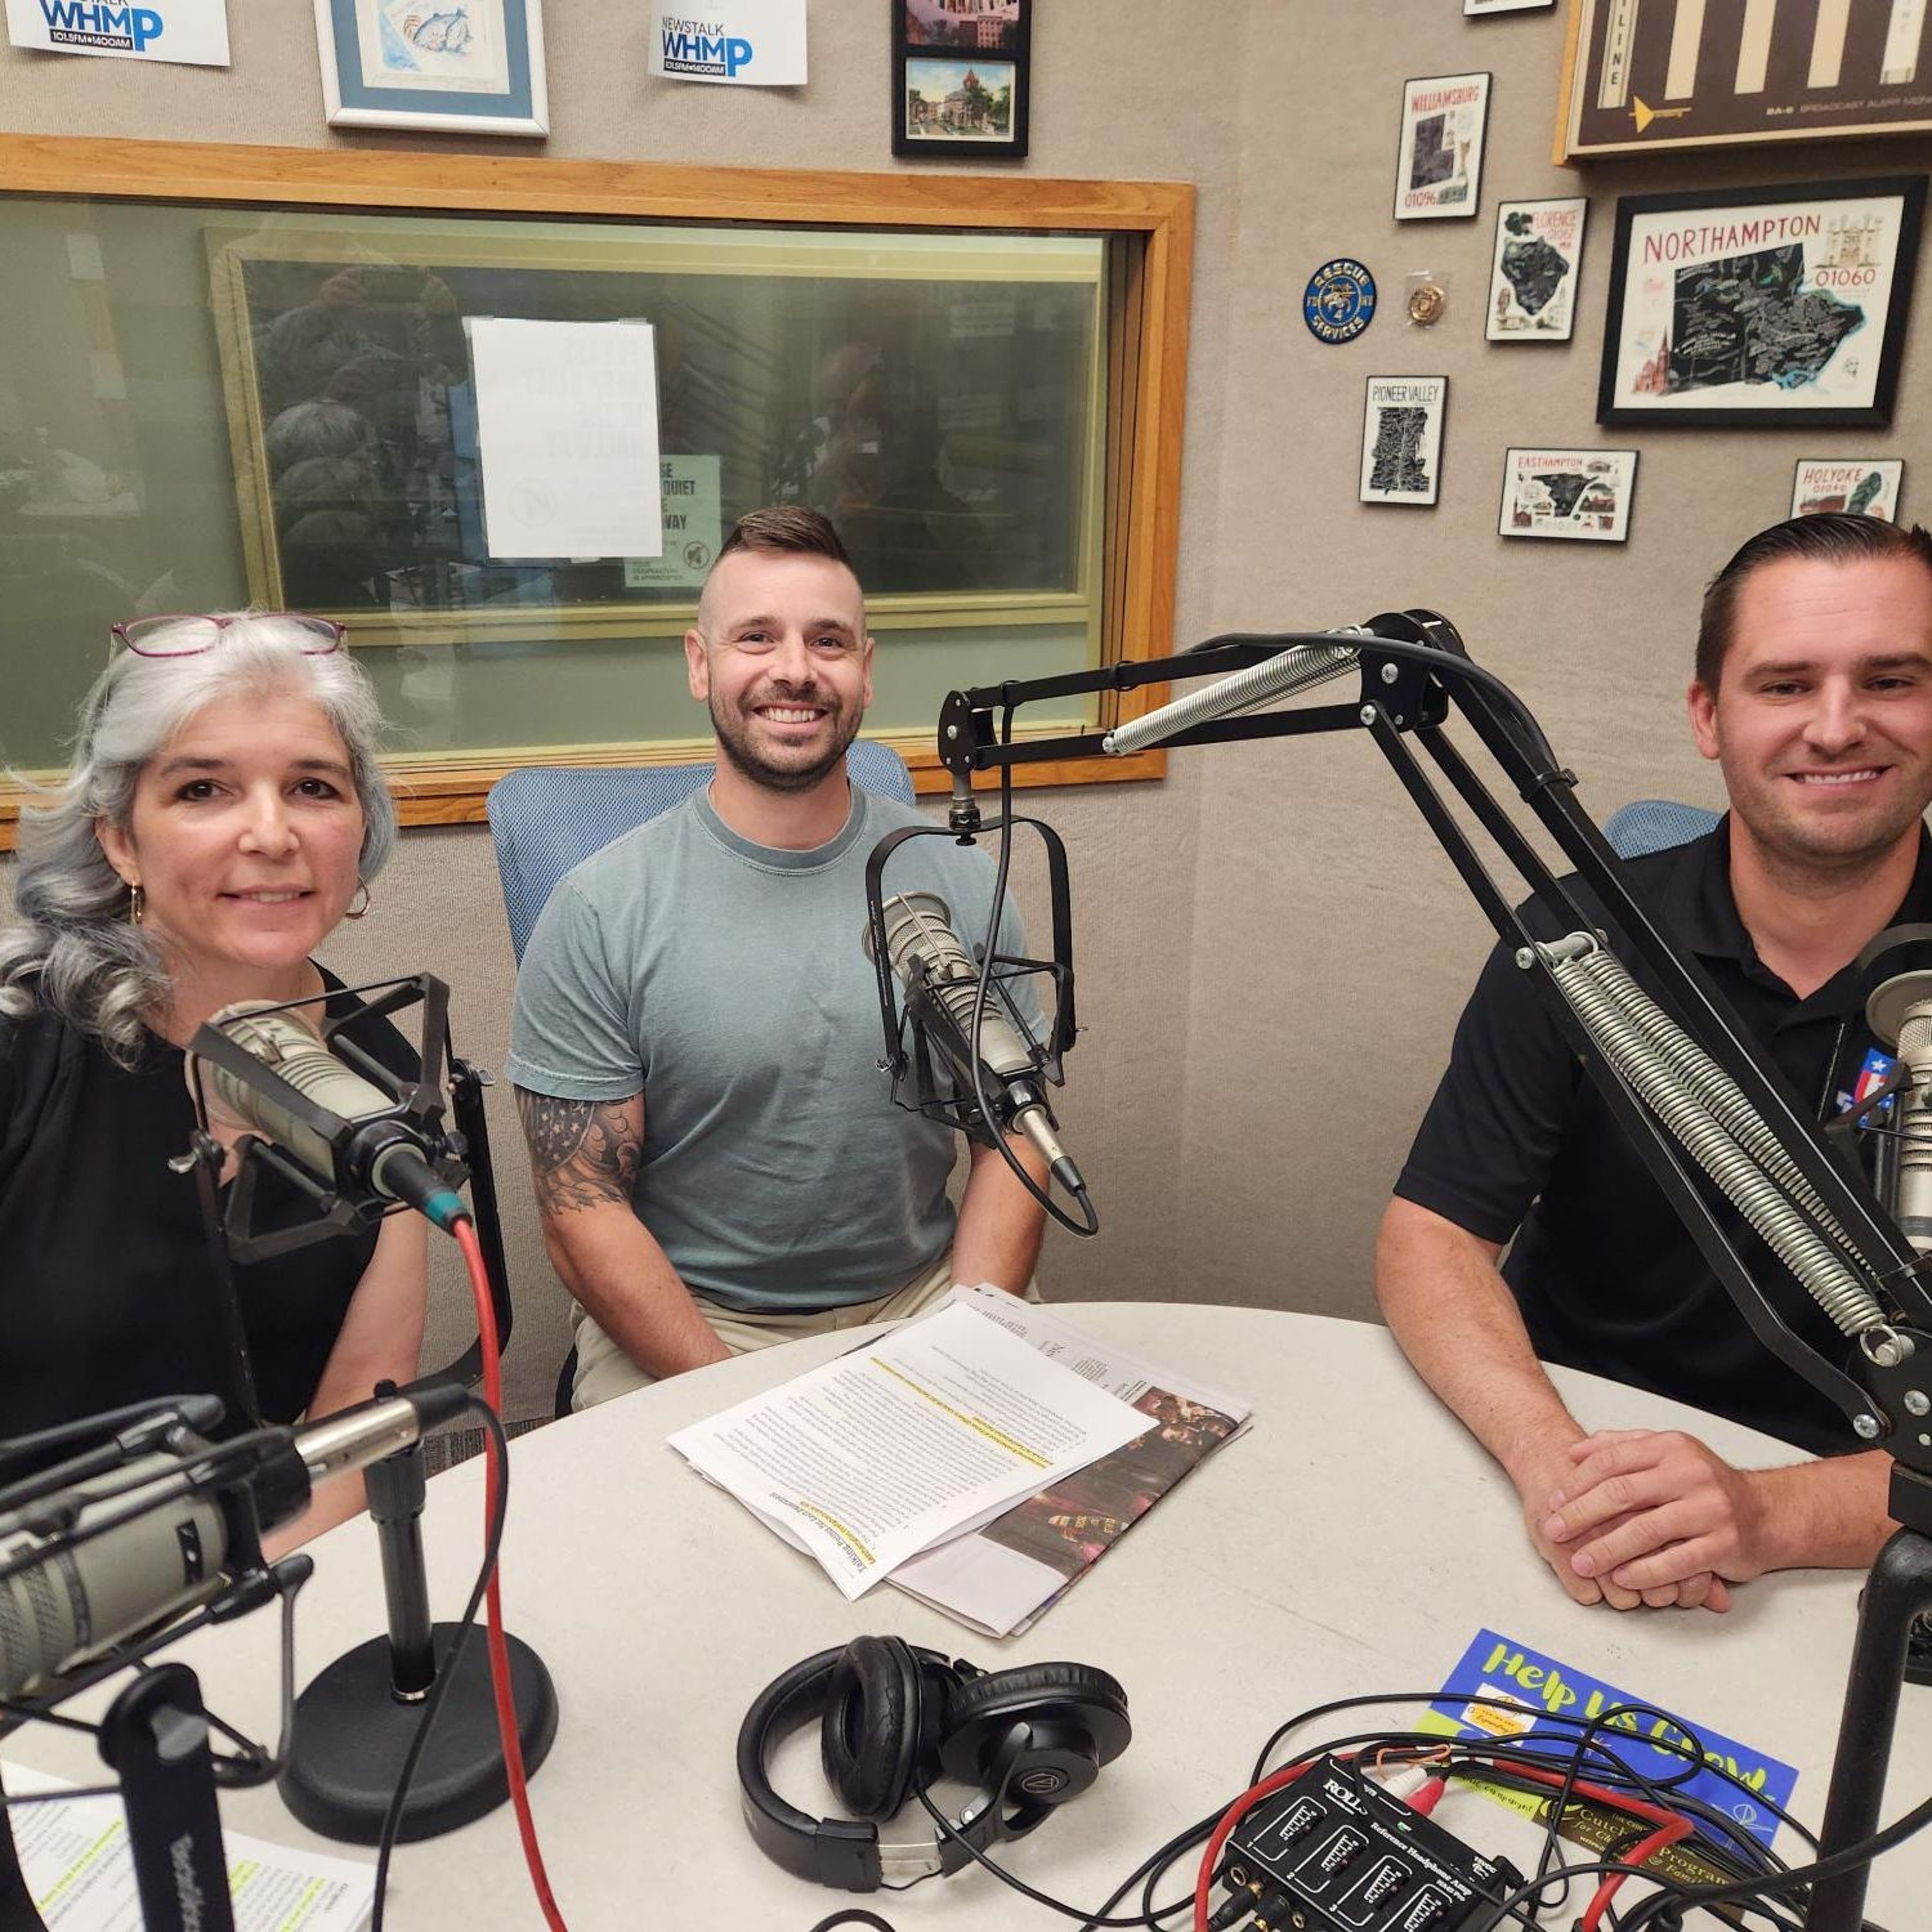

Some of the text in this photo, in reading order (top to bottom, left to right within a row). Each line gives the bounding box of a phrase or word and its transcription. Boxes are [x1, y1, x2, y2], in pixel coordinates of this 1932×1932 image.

[40, 0, 164, 52] WHMP
[661, 16, 724, 36] NEWSTALK
[661, 30, 753, 77] WHMP
[1412, 86, 1479, 113] WILLIAMSBURG
[1643, 214, 1821, 264] NORTHAMPTON
[1815, 268, 1877, 288] 01060
[1312, 315, 1365, 339] SERVICES
[1372, 386, 1440, 402] PIONEER VALLEY
[1518, 455, 1583, 469] EASTHAMPTON
[1804, 468, 1863, 484] HOLYOKE
[1482, 1643, 1577, 1713] Help
[1370, 1822, 1473, 1896] Reference Headphone Amp
[1286, 1871, 1296, 1880] 2
[1329, 1904, 1338, 1912] 3
